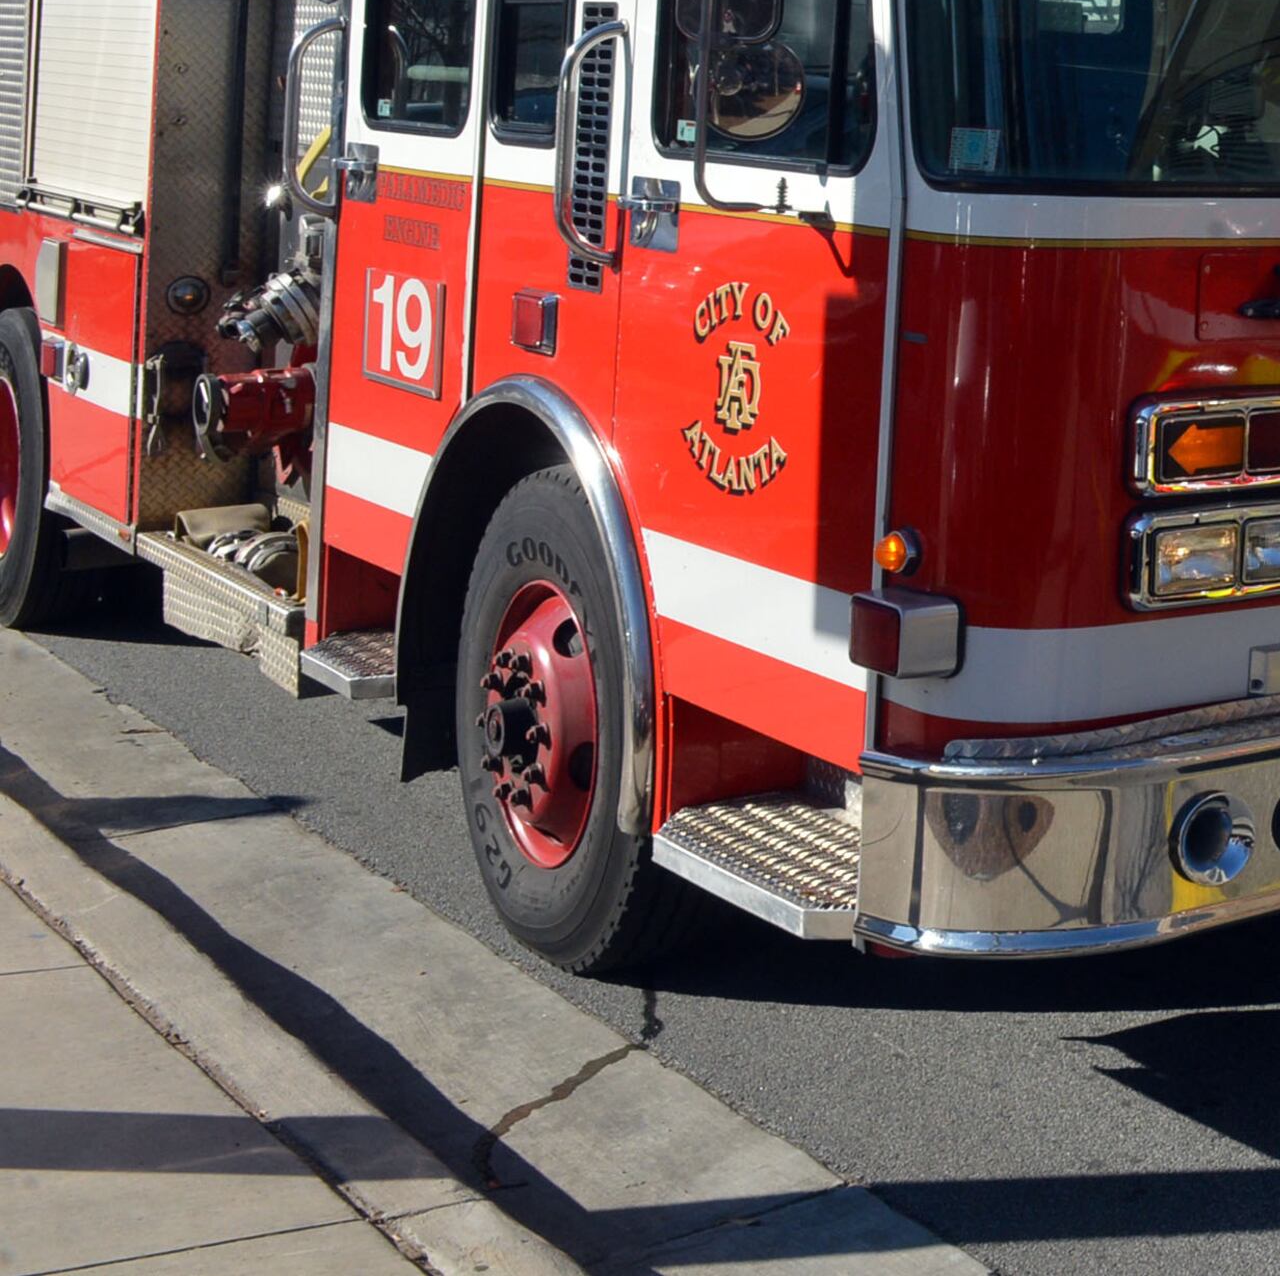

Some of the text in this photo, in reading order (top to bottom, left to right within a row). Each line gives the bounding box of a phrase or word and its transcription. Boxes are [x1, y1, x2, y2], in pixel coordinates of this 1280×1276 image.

[376, 172, 466, 211] PARAMEDIC
[384, 215, 441, 250] ENGINE
[372, 274, 433, 381] 19
[693, 281, 791, 346] CITY OF
[681, 420, 788, 496] ATLANTA
